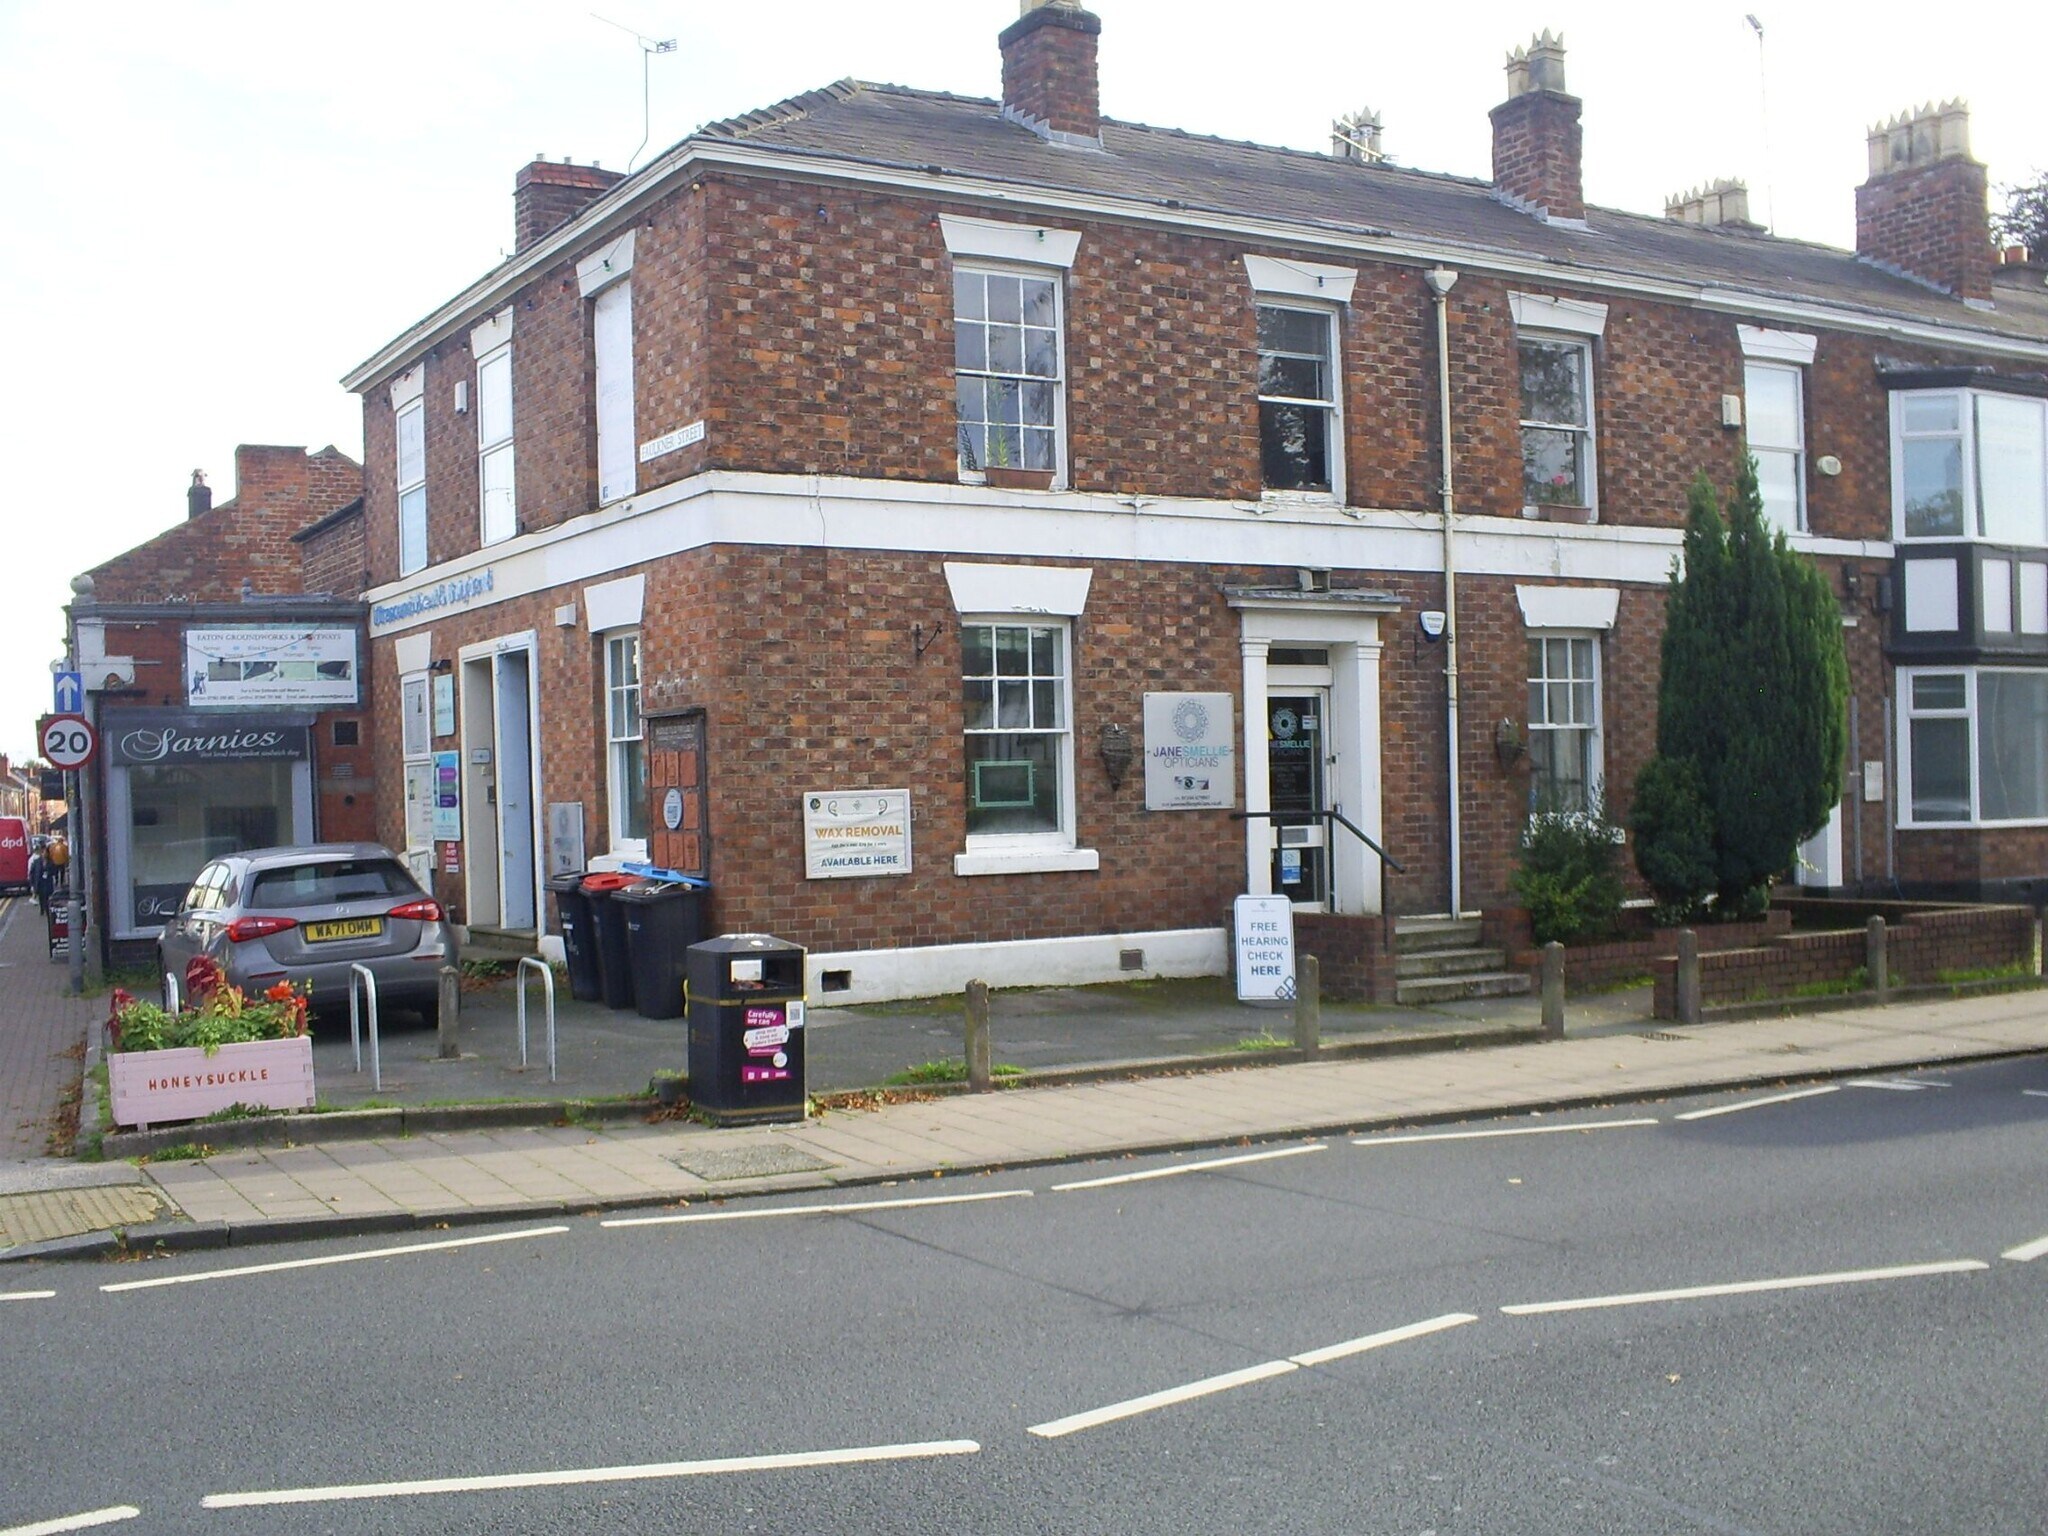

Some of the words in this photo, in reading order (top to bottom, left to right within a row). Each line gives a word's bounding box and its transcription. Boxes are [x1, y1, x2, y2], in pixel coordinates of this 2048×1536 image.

[641, 436, 674, 459] FAULKNER
[677, 423, 702, 445] STREET
[197, 633, 224, 642] EATON
[225, 633, 288, 641] GROUNDWORKS
[290, 633, 295, 641] &
[48, 730, 88, 755] 20
[121, 727, 284, 761] Sarnies
[1164, 756, 1219, 768] OPTICIANS
[815, 827, 842, 839] WAX
[846, 825, 903, 838] REMOVAL
[1, 837, 23, 849] dpd
[821, 857, 872, 867] AVAILABLE
[874, 855, 899, 865] HERE
[315, 923, 346, 938] WA71
[348, 920, 374, 935] OMM
[1250, 922, 1278, 932] FREE
[1241, 937, 1289, 947] HEARING
[1247, 951, 1284, 961] CHECK
[1250, 965, 1282, 976] HERE
[747, 1010, 778, 1020] Carefully
[148, 1068, 268, 1090] HONEYSUCKLE
